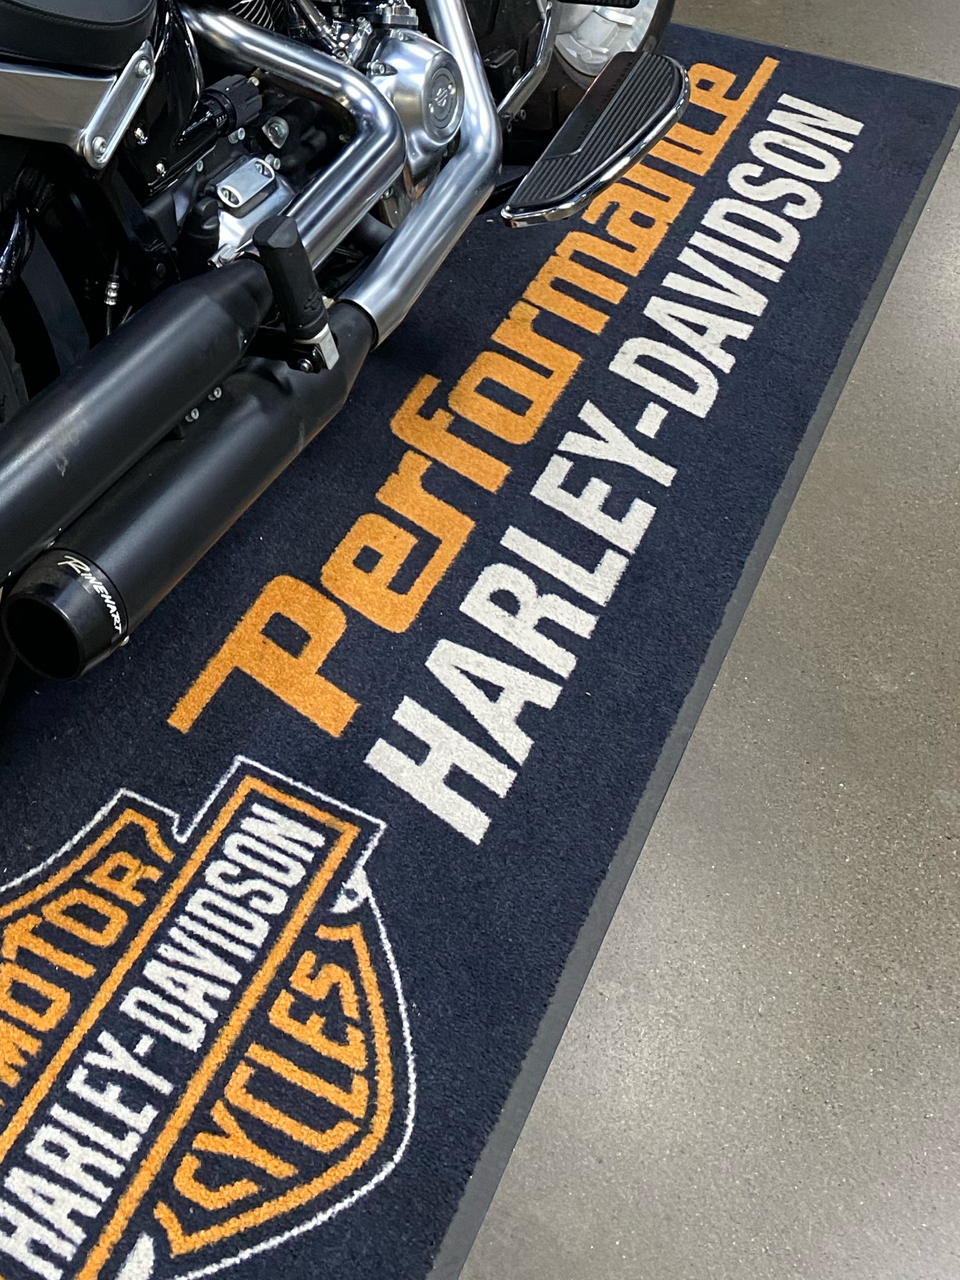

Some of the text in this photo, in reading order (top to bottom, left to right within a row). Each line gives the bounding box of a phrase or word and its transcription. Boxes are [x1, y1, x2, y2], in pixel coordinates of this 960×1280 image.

[57, 554, 123, 635] RINEHART
[364, 93, 865, 845] HARLEY-DAVIDSON
[172, 949, 372, 1210] CYCLES
